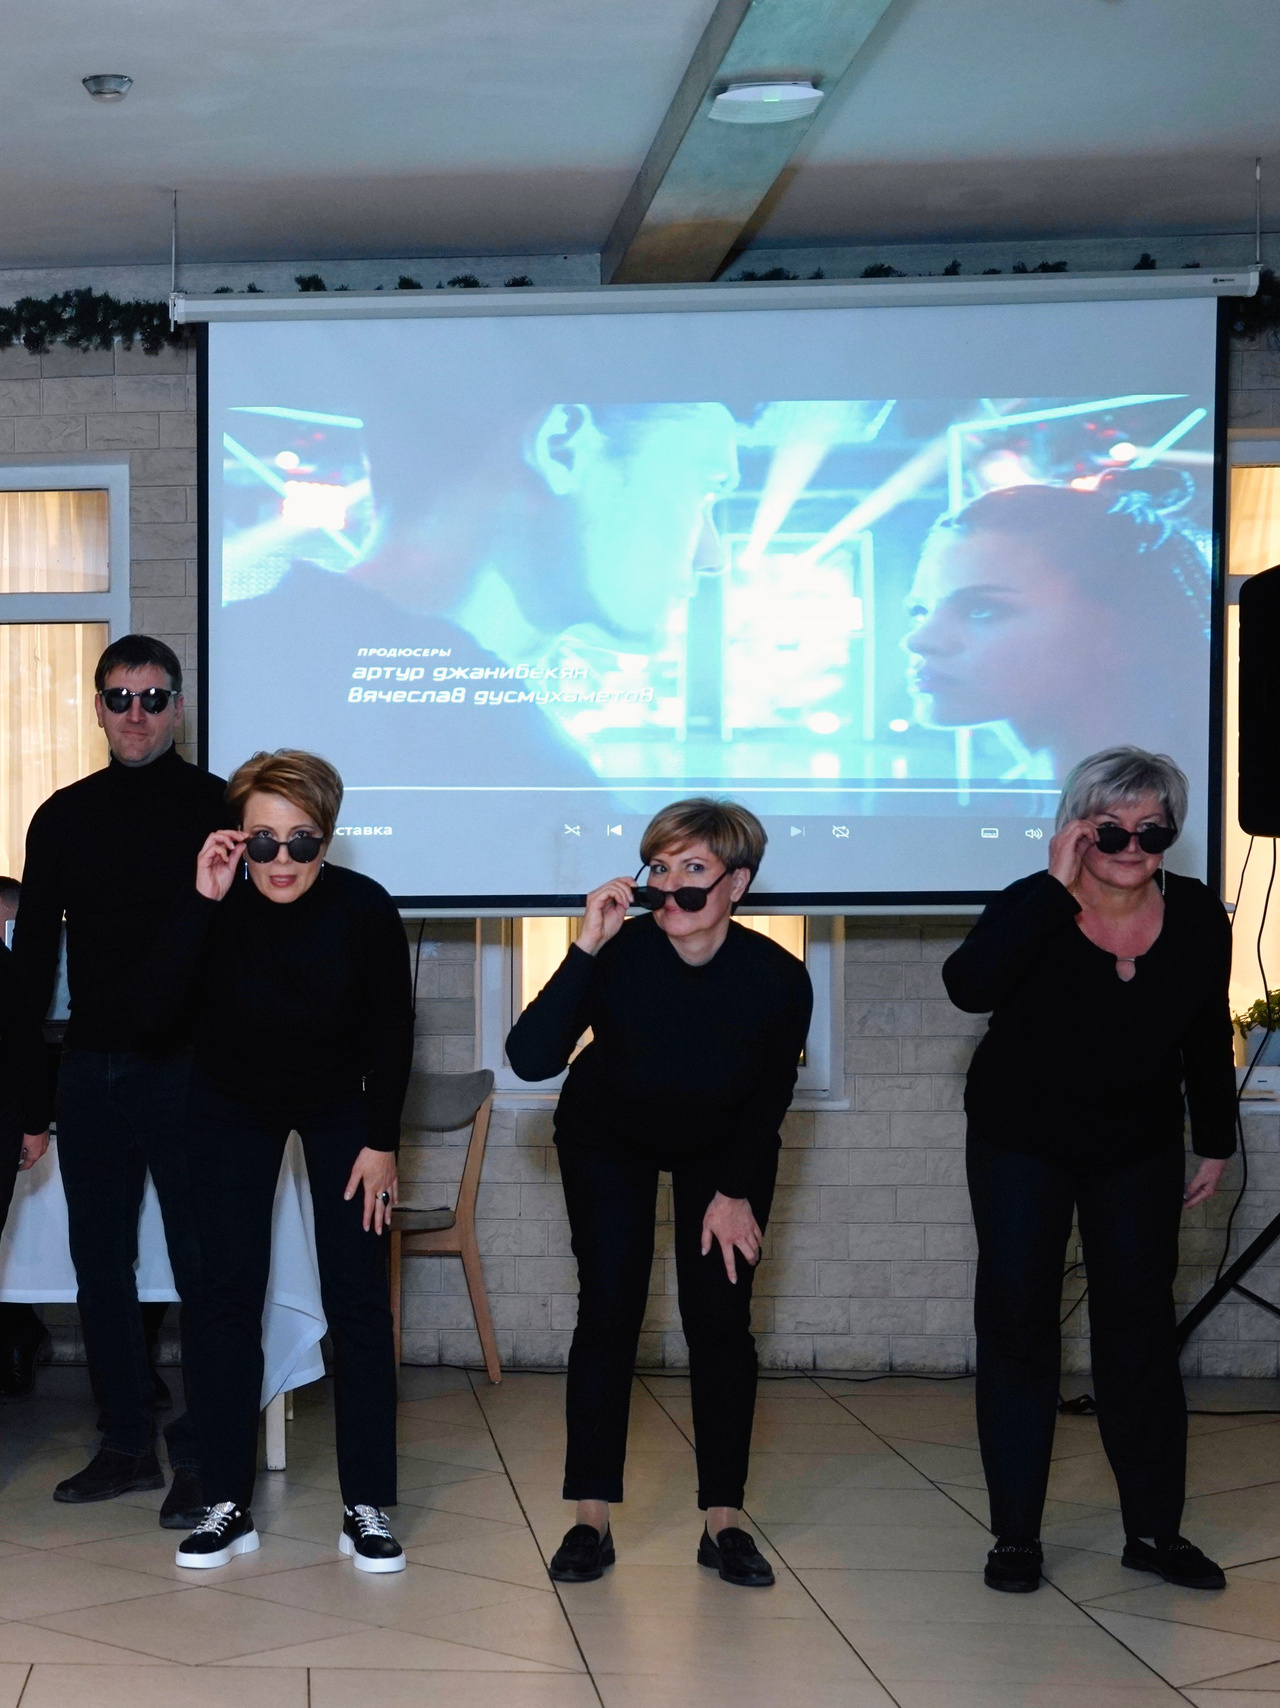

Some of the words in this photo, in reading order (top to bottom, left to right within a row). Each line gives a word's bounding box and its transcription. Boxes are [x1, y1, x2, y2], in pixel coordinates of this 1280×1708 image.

[357, 647, 452, 658] ПРОДЮСЕРЫ
[352, 665, 425, 681] артур
[347, 687, 466, 703] вячеслав
[333, 826, 393, 836] ставка
